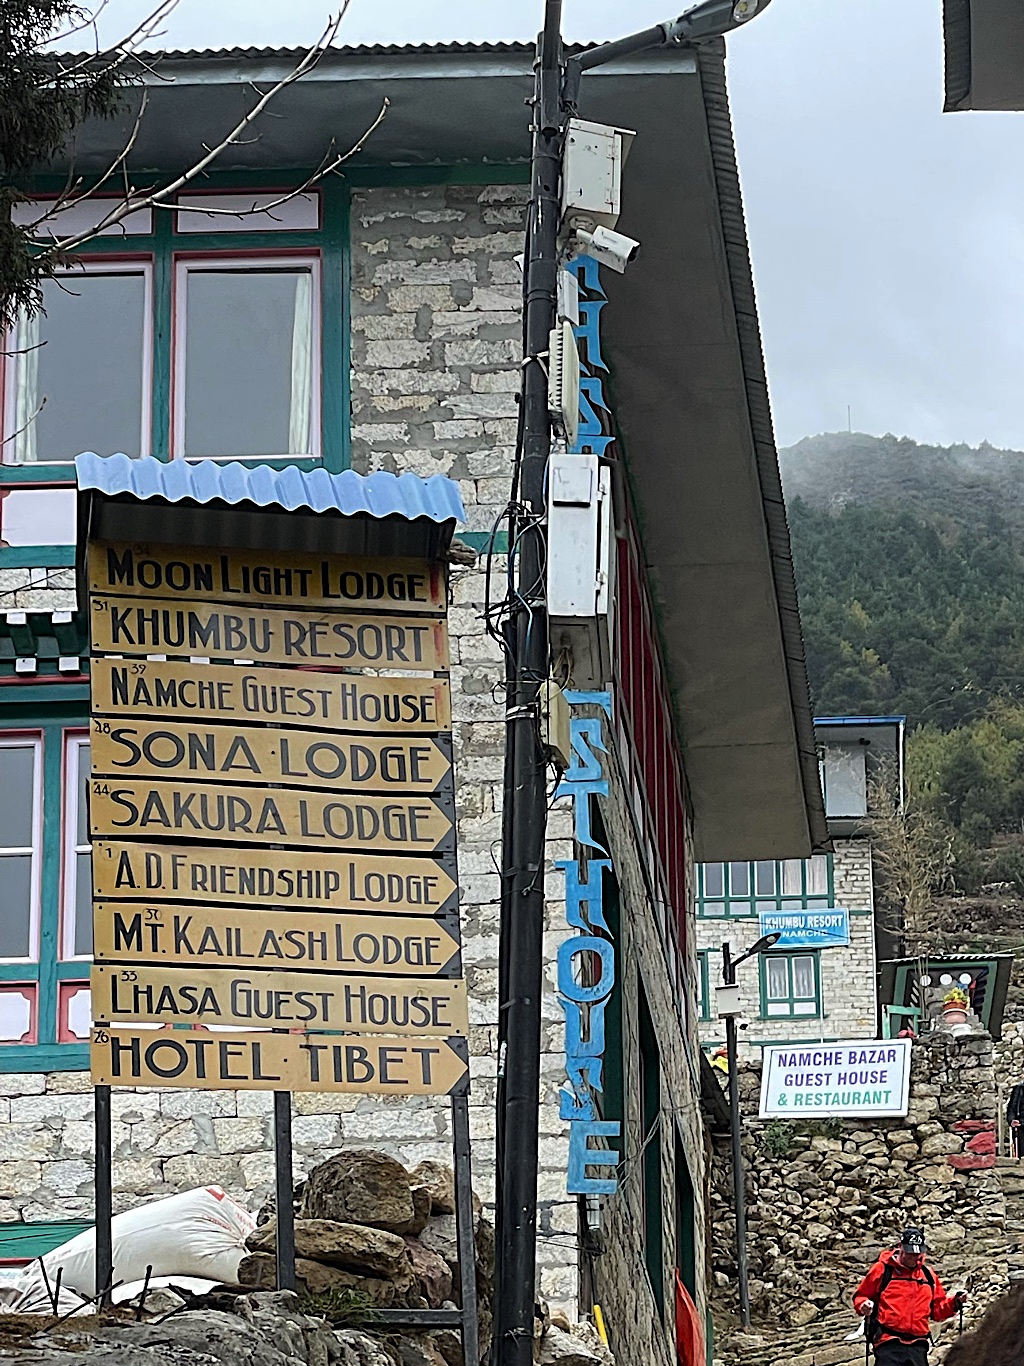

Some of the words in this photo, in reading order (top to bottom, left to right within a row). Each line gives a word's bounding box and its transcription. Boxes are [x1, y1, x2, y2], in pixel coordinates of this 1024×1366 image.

[107, 547, 214, 592] MOON
[220, 555, 313, 598] LIGHT
[321, 561, 428, 603] LODGE
[111, 606, 272, 653] KHUMBU
[284, 620, 429, 662] RESORT
[111, 666, 235, 711] NAMCHE
[241, 675, 333, 719] GUEST
[341, 683, 436, 723] HOUSE
[130, 664, 147, 675] 39
[110, 728, 262, 774] SONA
[281, 738, 433, 783] LODGE
[93, 784, 110, 796] 44
[110, 789, 288, 836] SAKURA
[299, 800, 435, 842] LODGE
[105, 847, 113, 859] 1
[171, 854, 340, 899] FRIENDSHIP
[349, 862, 441, 906] LODGE
[113, 912, 166, 954] MT.
[173, 915, 328, 961] KAILASH
[335, 923, 442, 966] LODGE
[765, 915, 805, 930] KHUMBU
[807, 914, 844, 929] RESORT
[782, 929, 829, 938] NAMCHE
[111, 974, 222, 1017] LHASA
[230, 979, 335, 1022] GUEST
[344, 985, 452, 1028] HOUSE
[93, 1029, 110, 1043] 26
[555, 859, 621, 1194] HOUSE
[110, 1036, 282, 1082] HOTEL
[299, 1044, 441, 1086] TIBET
[778, 1051, 843, 1068] NAMCHE
[848, 1049, 897, 1065] BAZAR
[784, 1072, 833, 1087] GUEST
[837, 1069, 888, 1086] HOUSE
[777, 1092, 788, 1106] &
[793, 1090, 892, 1106] RESTAURANT
